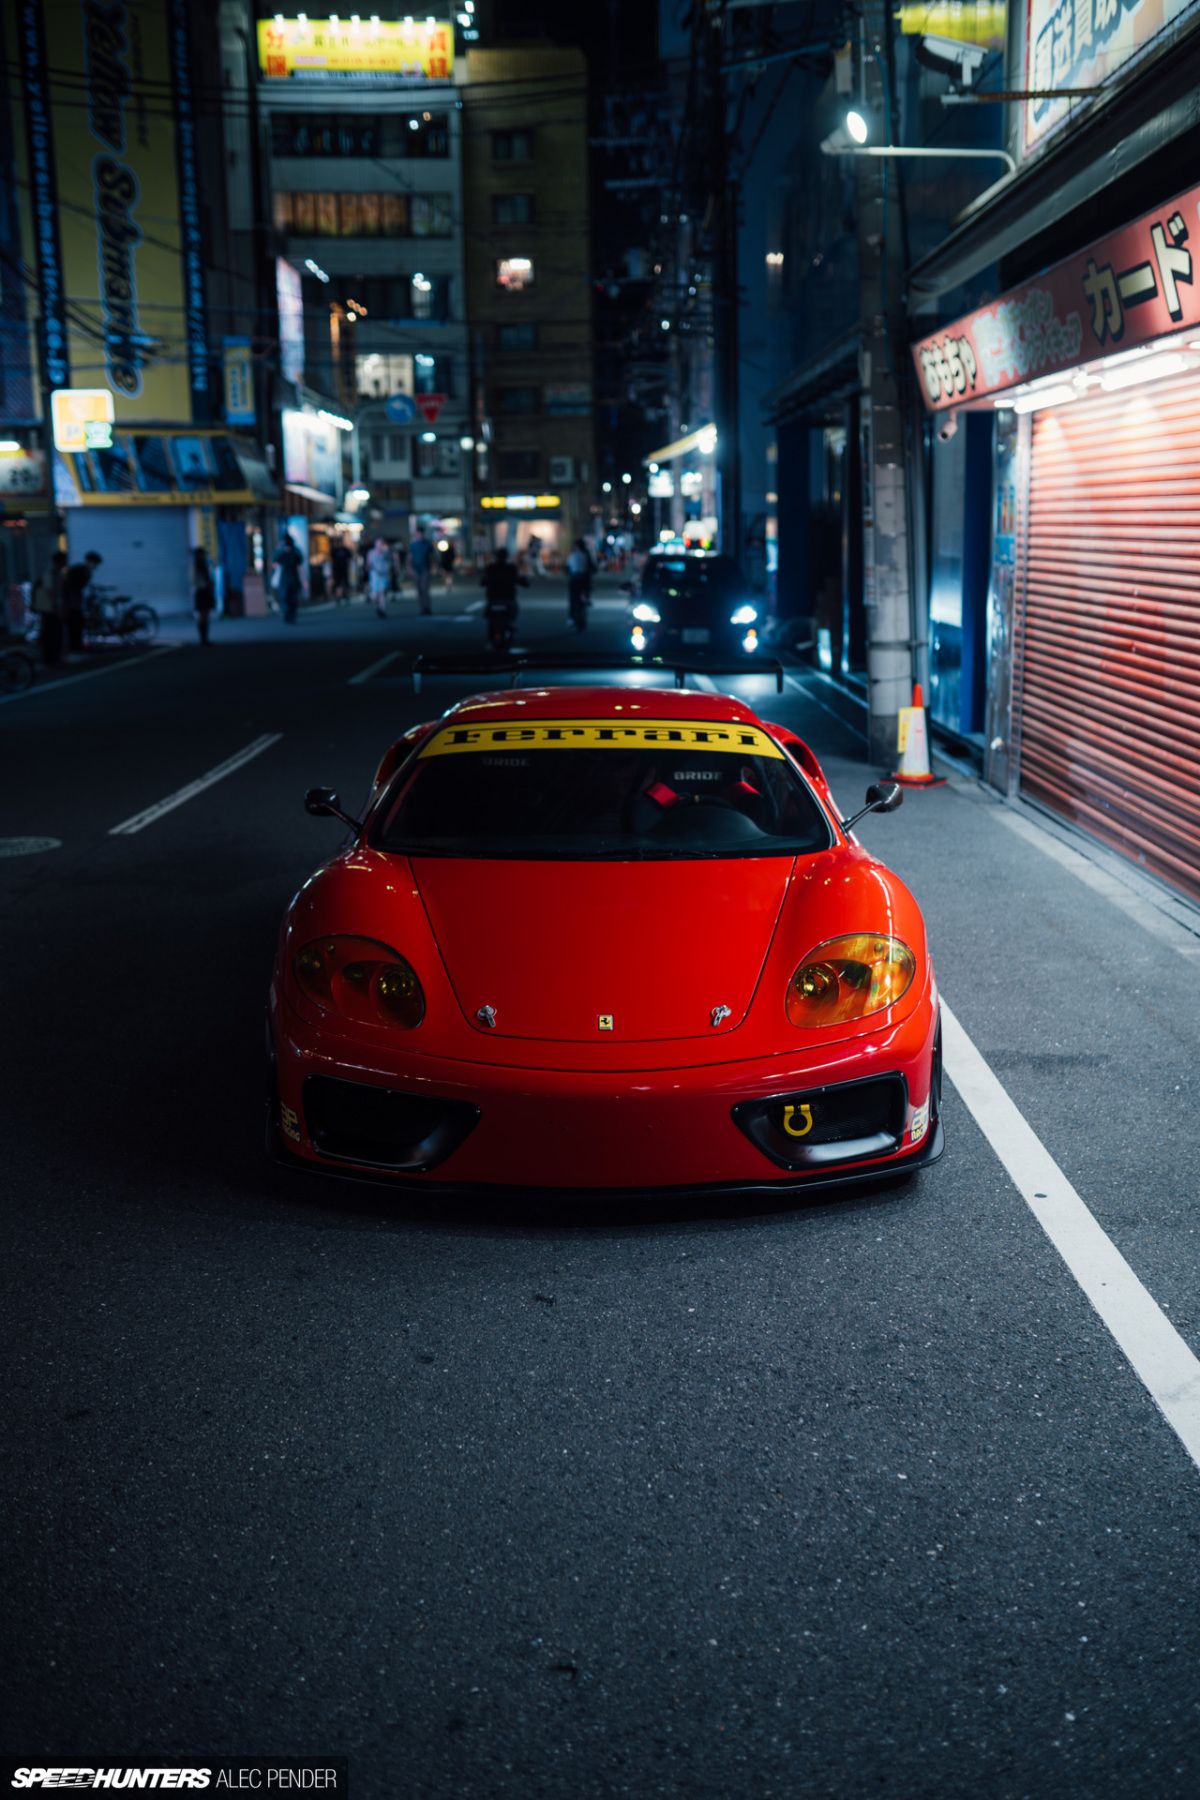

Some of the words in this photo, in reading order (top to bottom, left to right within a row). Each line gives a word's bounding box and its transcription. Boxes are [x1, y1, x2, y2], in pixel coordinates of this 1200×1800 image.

[84, 2, 134, 151] Yellow
[95, 158, 141, 394] Submarine
[919, 333, 978, 403] おもちゃ
[1082, 212, 1194, 346] カード
[444, 726, 760, 747] Ferrari
[482, 757, 531, 768] BRIDE
[673, 771, 723, 781] BRIDE
